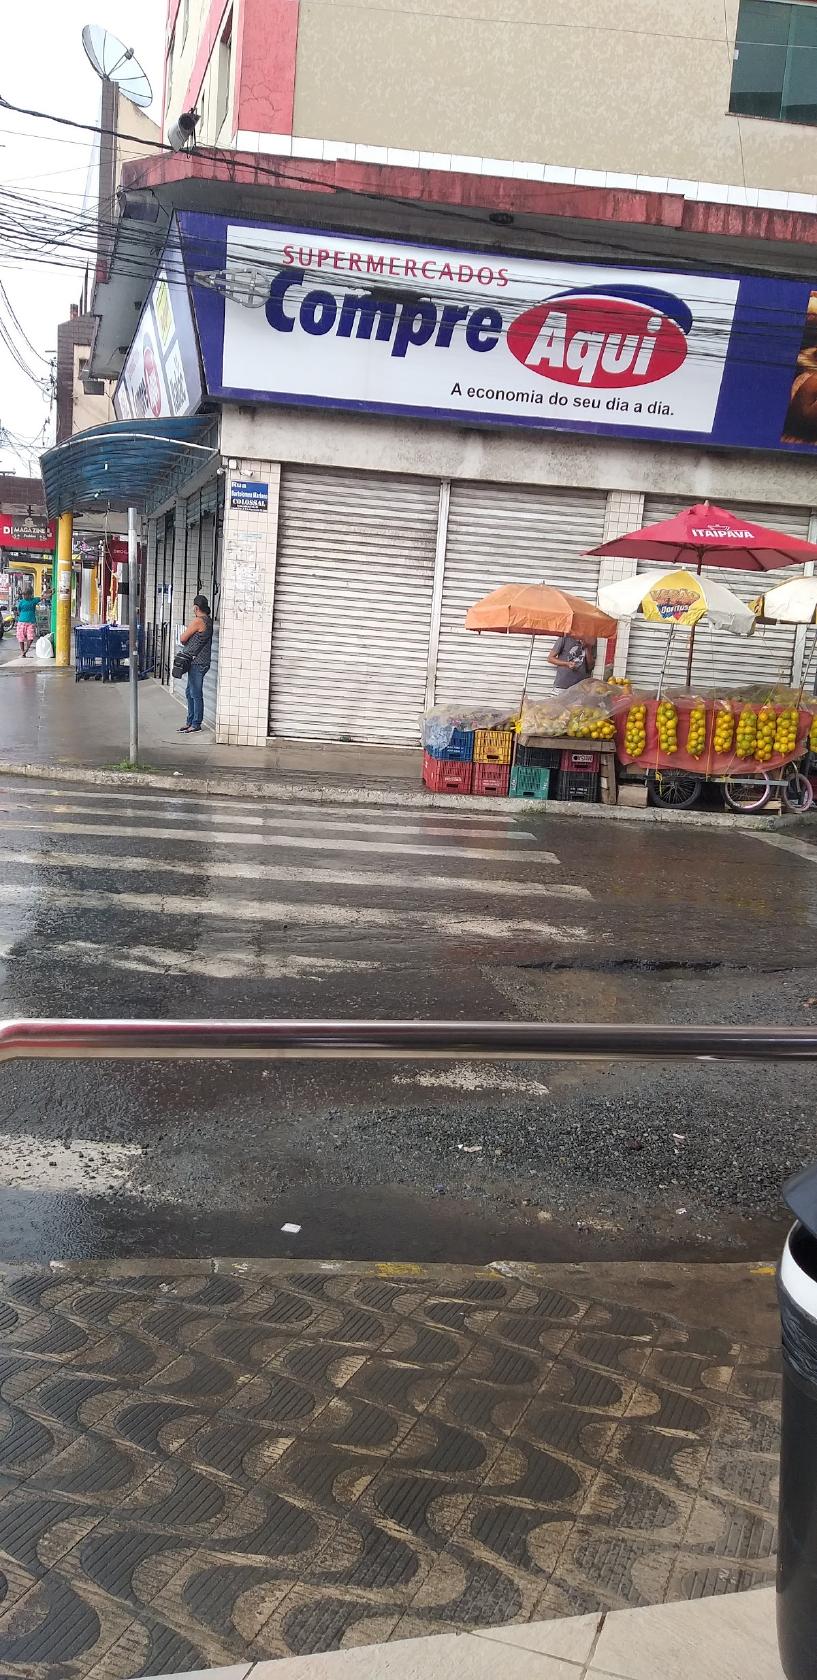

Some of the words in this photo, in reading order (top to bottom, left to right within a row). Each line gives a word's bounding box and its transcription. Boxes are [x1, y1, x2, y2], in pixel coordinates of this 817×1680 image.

[282, 245, 510, 287] SUPERMERCADOS
[265, 268, 503, 358] Compre
[524, 311, 663, 384] Aqui
[451, 383, 462, 396] A
[467, 386, 543, 404] economia
[549, 392, 569, 406] do
[573, 397, 601, 409] seu
[606, 398, 629, 412] dia
[633, 403, 643, 413] a
[647, 401, 675, 416] dia.
[231, 481, 247, 489] Rua
[232, 498, 266, 507] COLOSSAL
[691, 528, 755, 539] ITAIPAVA
[661, 604, 689, 614] Doritos
